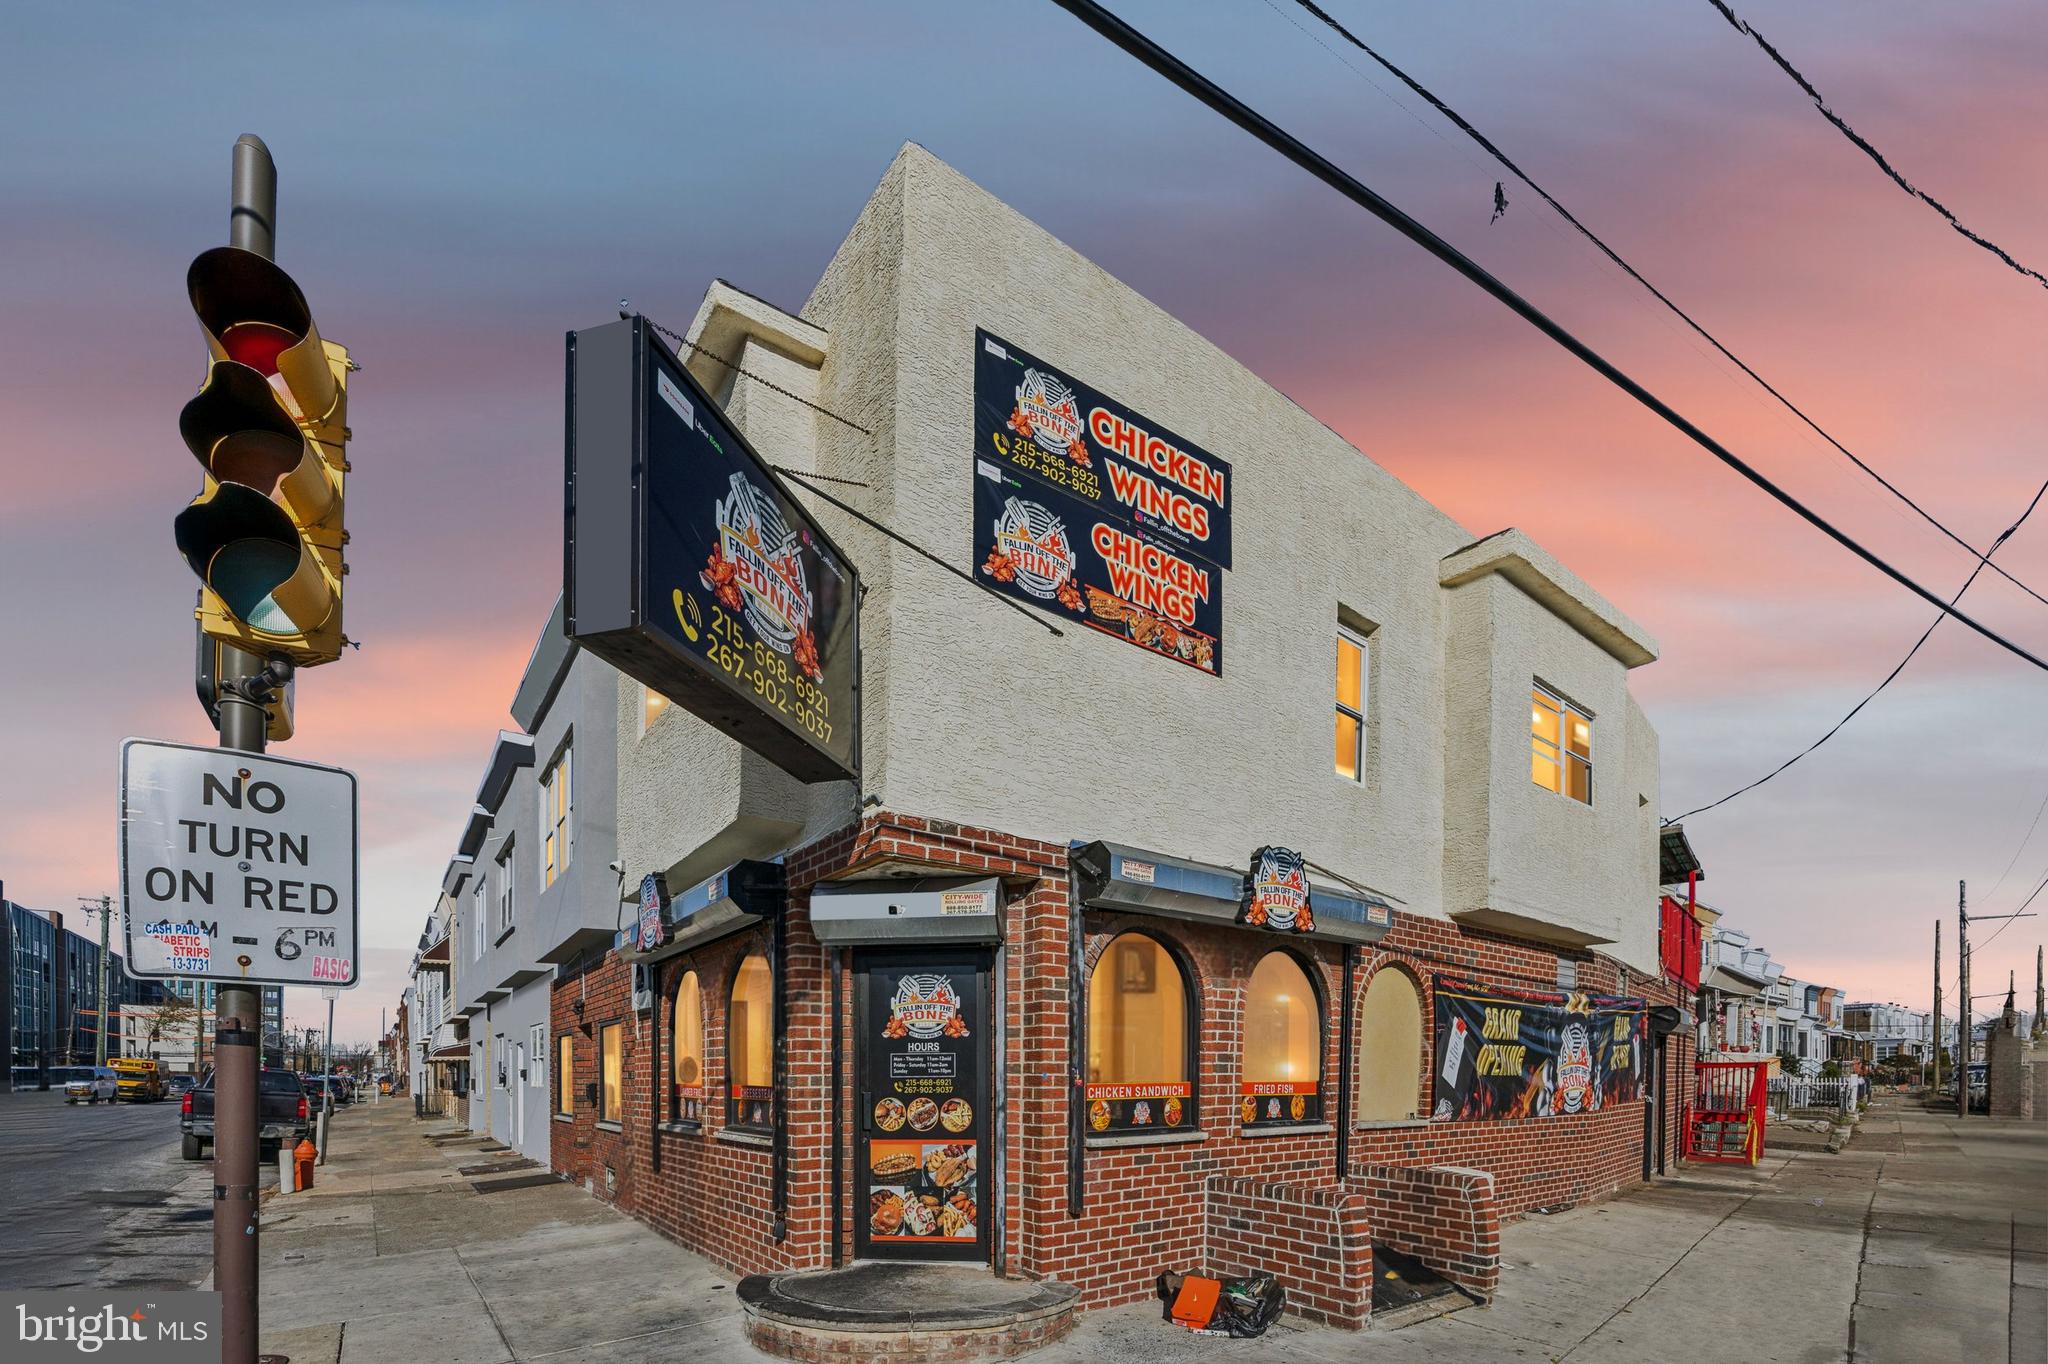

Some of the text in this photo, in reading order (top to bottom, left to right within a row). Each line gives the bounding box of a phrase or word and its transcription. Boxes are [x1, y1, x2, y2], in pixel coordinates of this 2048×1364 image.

[1024, 403, 1076, 432] FALLIN OFF THE
[1028, 411, 1071, 439] BONE
[1015, 438, 1098, 487] 215-668-6921
[1089, 407, 1224, 509] CHICKEN
[1012, 450, 1101, 500] 267-902-9037
[1104, 458, 1210, 540] WINGS
[1004, 538, 1067, 571] FALLIN OFF THE
[1092, 522, 1208, 605] CHICKEN
[729, 538, 764, 574] FALLIN
[768, 569, 785, 592] OFF
[788, 588, 804, 618] THE
[736, 556, 798, 629] BONE
[1106, 560, 1196, 626] WINGS
[746, 611, 755, 626] GET
[758, 627, 770, 642] YOUR
[783, 644, 790, 652] ON
[712, 606, 828, 717] 215-668-6921
[707, 634, 832, 743] 267-902-9037
[203, 773, 286, 814] NO
[178, 819, 308, 866] TURN
[145, 867, 339, 916] ON RED
[1264, 894, 1298, 909] BONE
[1280, 887, 1290, 895] OFF
[146, 924, 172, 934] CASH
[176, 925, 200, 936] PAID
[275, 929, 302, 960] 6
[305, 930, 334, 947] PM
[166, 957, 209, 971] 13-3731
[174, 946, 210, 958] STRIPS
[312, 956, 350, 980] BASIC
[903, 1010, 946, 1020] BONE
[1482, 1007, 1521, 1040] GRAND
[908, 1042, 940, 1051] HOURS
[1476, 1044, 1526, 1076] OPENING
[1088, 1085, 1184, 1098] CHICKEN SANDWICH
[1254, 1084, 1294, 1094] FRIED FISH
[1563, 1074, 1585, 1088] BONE
